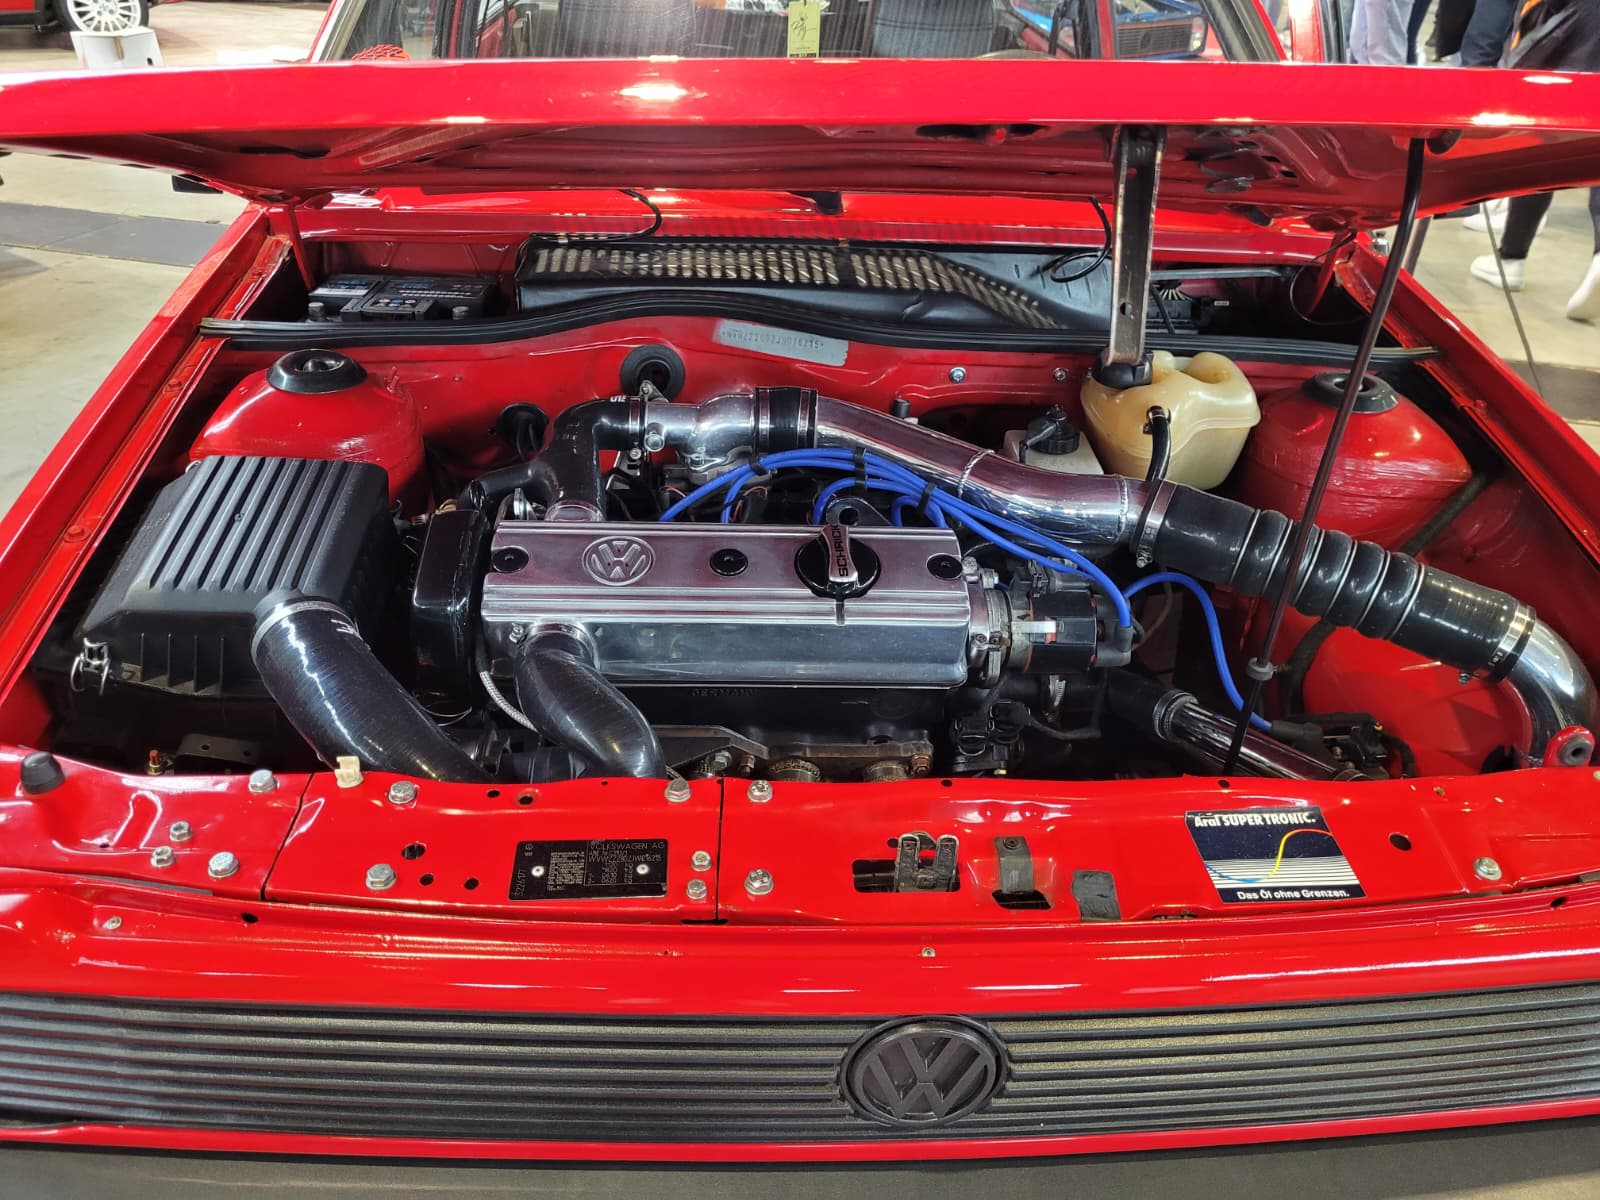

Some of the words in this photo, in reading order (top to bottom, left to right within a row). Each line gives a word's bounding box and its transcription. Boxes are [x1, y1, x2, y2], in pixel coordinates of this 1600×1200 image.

[830, 524, 848, 577] SCHRICK
[1194, 814, 1221, 827] Aral
[652, 841, 665, 849] AG
[1236, 891, 1259, 900] Das
[1260, 889, 1272, 899] Öl
[1273, 890, 1301, 899] ohne
[1301, 889, 1350, 898] Grenzen.
